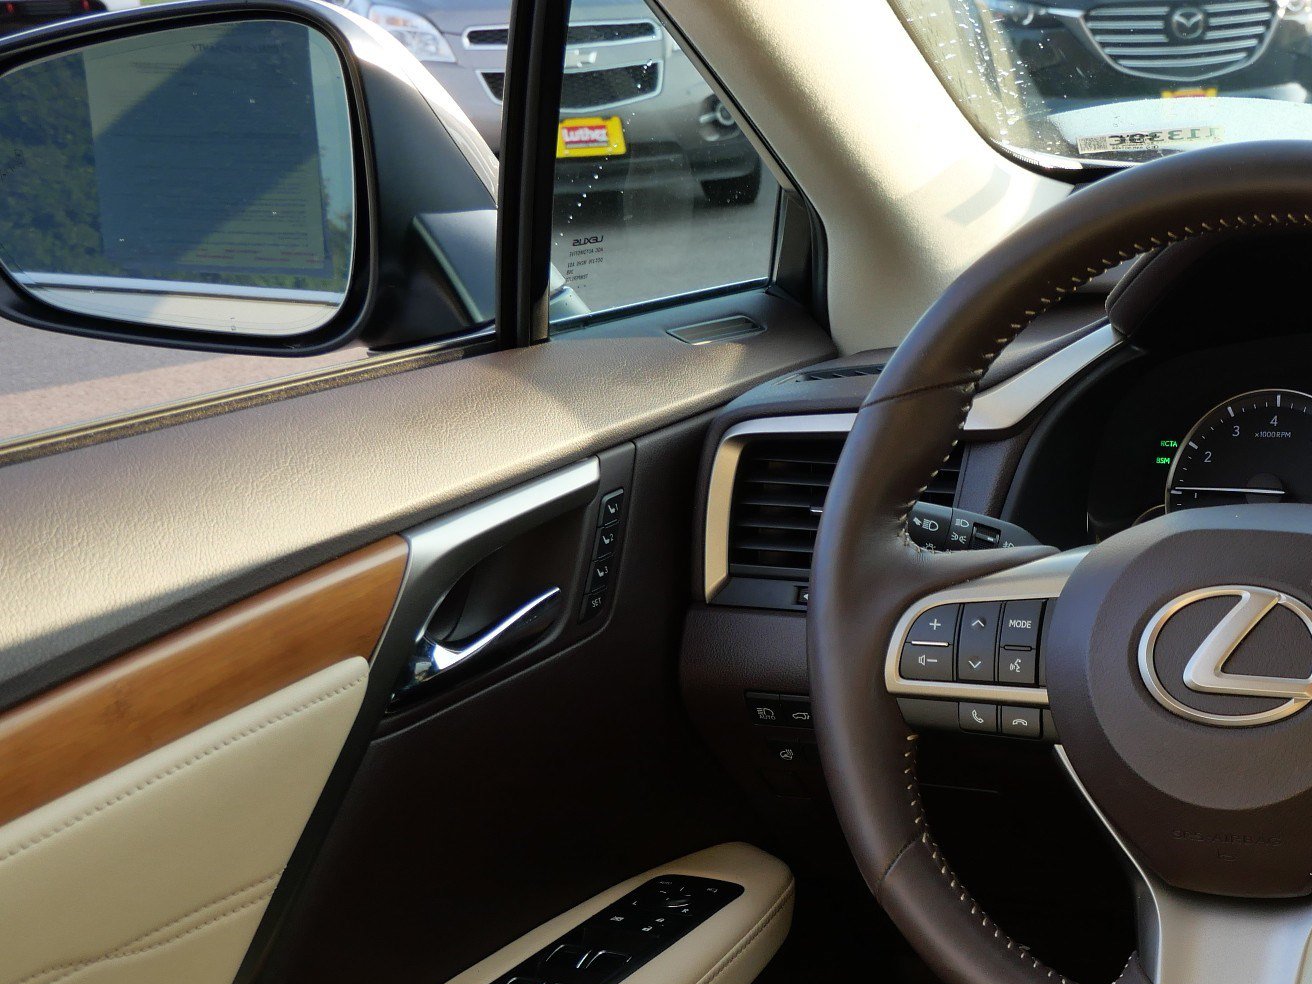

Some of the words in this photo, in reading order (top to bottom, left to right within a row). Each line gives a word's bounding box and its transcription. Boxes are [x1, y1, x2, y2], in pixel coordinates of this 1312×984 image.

[1270, 415, 1279, 427] 4
[1232, 425, 1240, 437] 3
[1160, 440, 1178, 448] RCTA
[1156, 457, 1170, 465] BSM
[1204, 451, 1212, 463] 2
[1008, 619, 1032, 629] MODE
